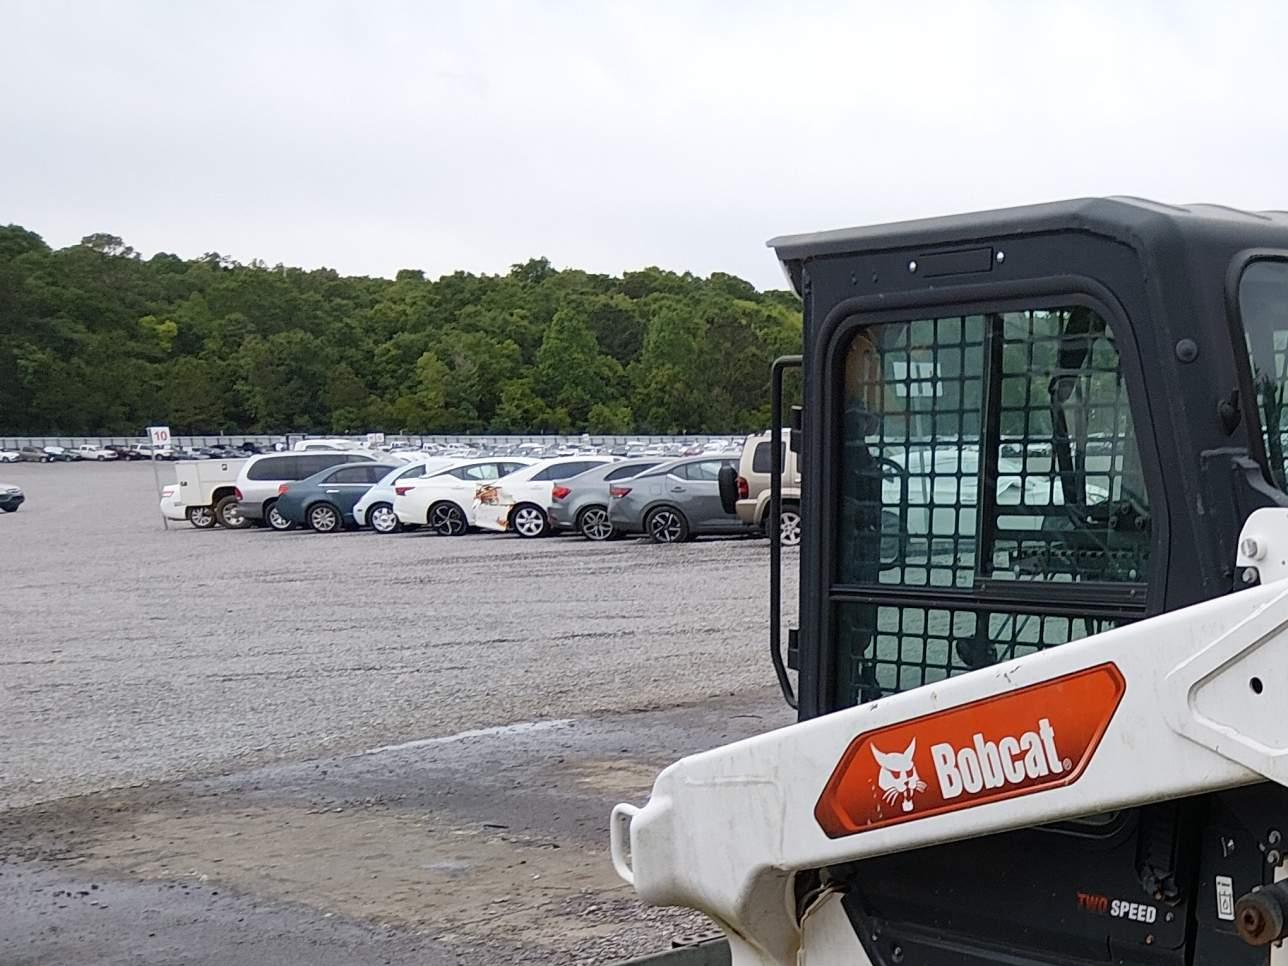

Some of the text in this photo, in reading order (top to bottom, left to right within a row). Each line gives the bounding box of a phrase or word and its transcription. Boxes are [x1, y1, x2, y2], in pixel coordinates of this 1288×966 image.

[154, 431, 167, 441] 10
[931, 718, 1063, 799] Bobcat
[1076, 892, 1157, 923] TWO SPEED
